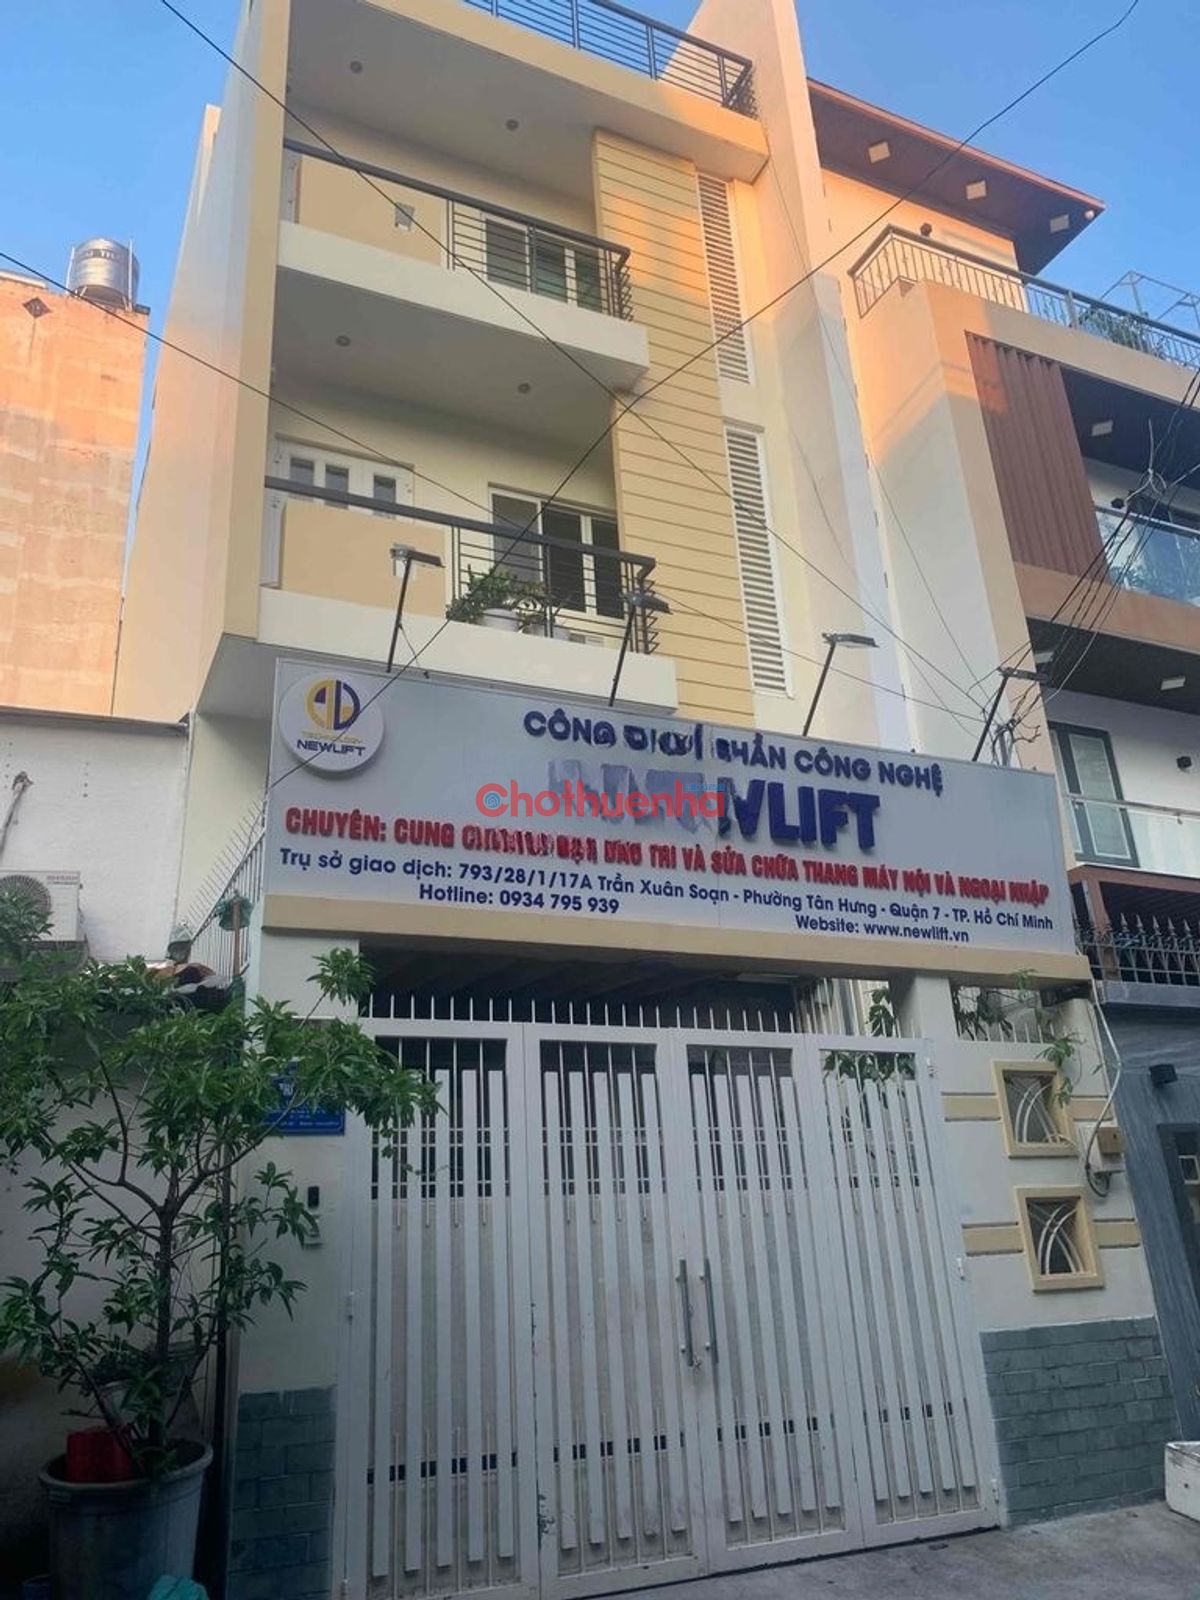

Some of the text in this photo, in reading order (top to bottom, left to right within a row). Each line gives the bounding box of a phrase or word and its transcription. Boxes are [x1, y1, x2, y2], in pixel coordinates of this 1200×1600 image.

[297, 739, 366, 757] NEWLIFT
[794, 746, 872, 781] CÔNG
[878, 762, 944, 797] NGHỆ
[285, 806, 387, 842] CHUYÊN:
[394, 818, 456, 849] CUNG
[682, 844, 706, 873] VÀ
[711, 846, 748, 878] SỬA
[752, 853, 799, 882] CHỮA
[803, 860, 859, 888] THANG
[862, 864, 898, 891] MÁY
[934, 871, 956, 897] VÀ
[958, 876, 1006, 905] NGOẠI
[280, 848, 311, 871] Trụ
[318, 850, 343, 869] sở
[350, 855, 396, 875] giao
[403, 859, 452, 880] dịch:
[459, 863, 593, 890] 793/28/1/17A
[598, 872, 634, 893] Trần
[640, 879, 684, 898] Xuân
[689, 883, 729, 904] Soạn
[743, 888, 801, 912] Phường
[806, 895, 834, 911] Tân
[839, 898, 877, 918] Hưng
[889, 903, 929, 922] Quận
[933, 906, 940, 920] 7
[952, 908, 970, 923] TP.
[974, 907, 992, 924] Hồ
[997, 911, 1019, 927] Chí
[1022, 914, 1053, 930] Minh
[419, 883, 620, 914] Hotline: 0934 795 939
[795, 914, 970, 943] Website: www.newlift.vn
